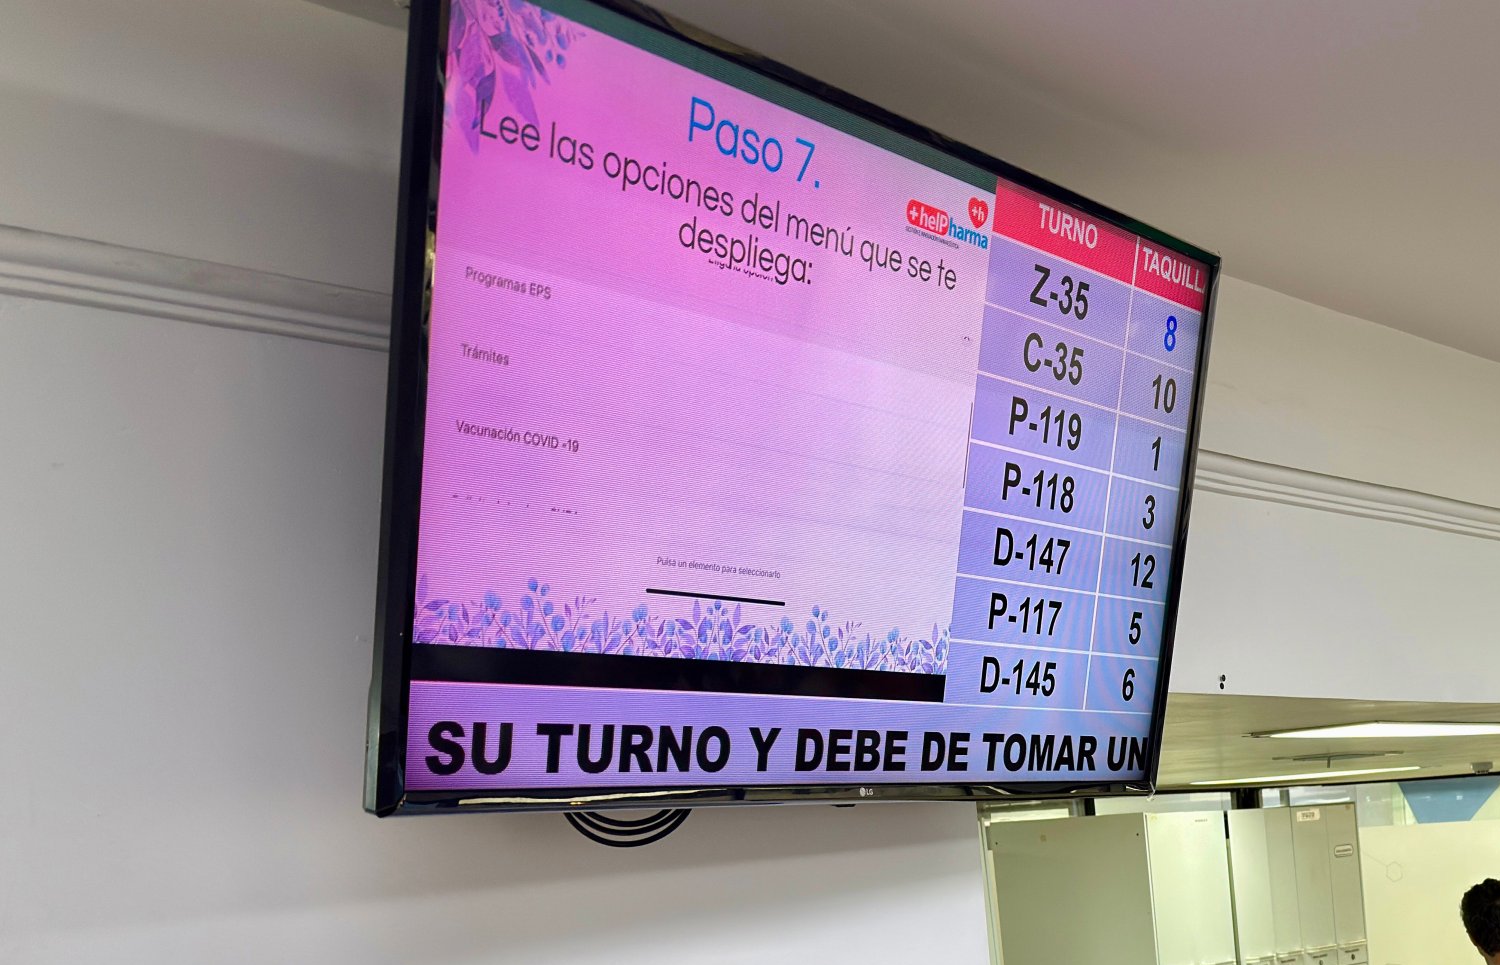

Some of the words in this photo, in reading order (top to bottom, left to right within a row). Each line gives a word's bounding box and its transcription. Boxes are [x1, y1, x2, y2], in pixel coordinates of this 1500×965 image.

[688, 96, 783, 173] Paso
[795, 137, 821, 189] 7.
[479, 98, 540, 152] Lee
[550, 121, 594, 170] las
[603, 151, 734, 217] opciones
[741, 192, 780, 233] del
[786, 213, 854, 257] menú
[860, 239, 902, 272] que
[907, 255, 932, 282] se
[937, 258, 957, 290] te
[678, 215, 813, 286] despliega:
[1038, 203, 1098, 249] TURNO
[1142, 246, 1205, 294] TAQUILL
[465, 265, 527, 295] Programas
[529, 282, 552, 300] EPS
[1029, 264, 1090, 321] Z-35
[1163, 315, 1178, 352] 8
[461, 342, 509, 366] Trámites
[1023, 332, 1084, 386] C-35
[1152, 374, 1177, 414] 10
[455, 419, 521, 443] Vacunación
[523, 431, 559, 450] COVID
[1008, 396, 1082, 451] P-119
[1152, 436, 1162, 471] 1
[1002, 461, 1075, 513] P-118
[1142, 494, 1156, 530] 3
[656, 557, 676, 566] Pulsa
[688, 560, 720, 572] elemento
[721, 565, 737, 574] para
[738, 567, 781, 579] seleccionarlo
[993, 527, 1071, 575] D-147
[1130, 552, 1156, 589] 12
[988, 592, 1063, 636] P-117
[1128, 611, 1143, 645] 5
[979, 655, 1057, 697] D-145
[1122, 668, 1136, 702] 6
[424, 720, 513, 776] SU
[536, 722, 732, 774] TURNO
[748, 727, 782, 772] Y
[794, 728, 909, 772] DEBE
[920, 731, 971, 772] DE
[982, 733, 1098, 772] TOMAR
